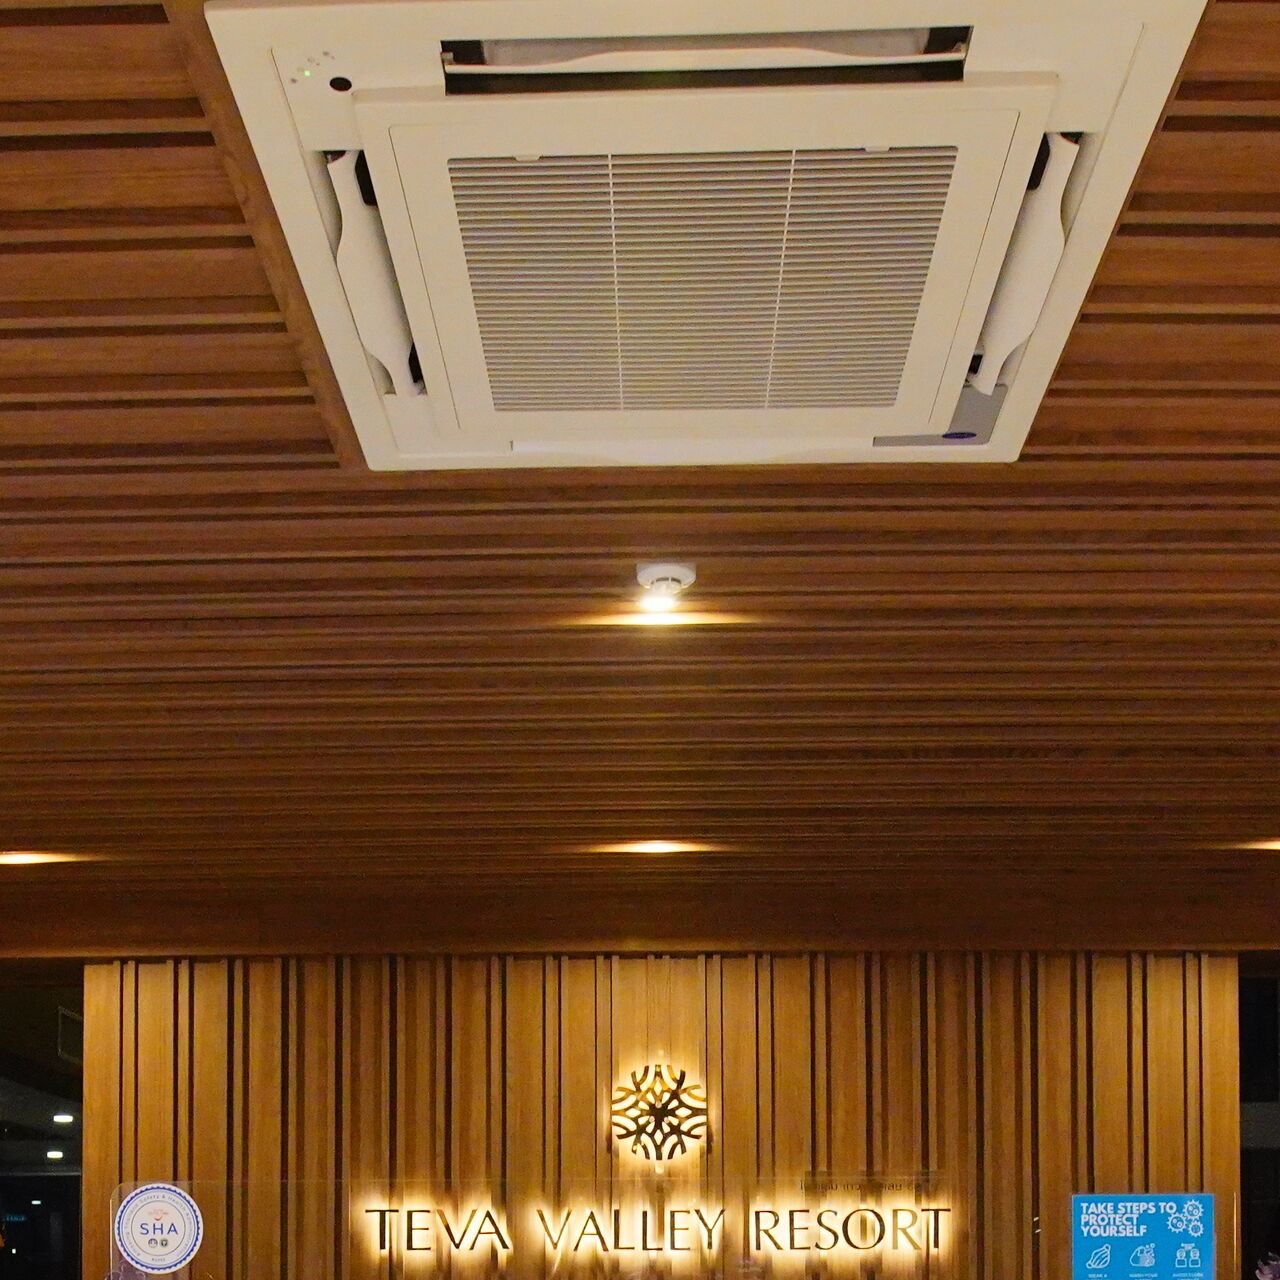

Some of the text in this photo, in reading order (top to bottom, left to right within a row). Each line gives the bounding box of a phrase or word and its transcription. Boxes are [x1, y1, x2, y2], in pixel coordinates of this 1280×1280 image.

[1080, 1202, 1177, 1214] TAKE STEPS TO
[1080, 1214, 1138, 1226] PROTECT
[140, 1223, 178, 1235] SHA
[365, 1208, 951, 1251] TEVA VALLEY RESORT
[1080, 1225, 1147, 1237] YOURSELF
